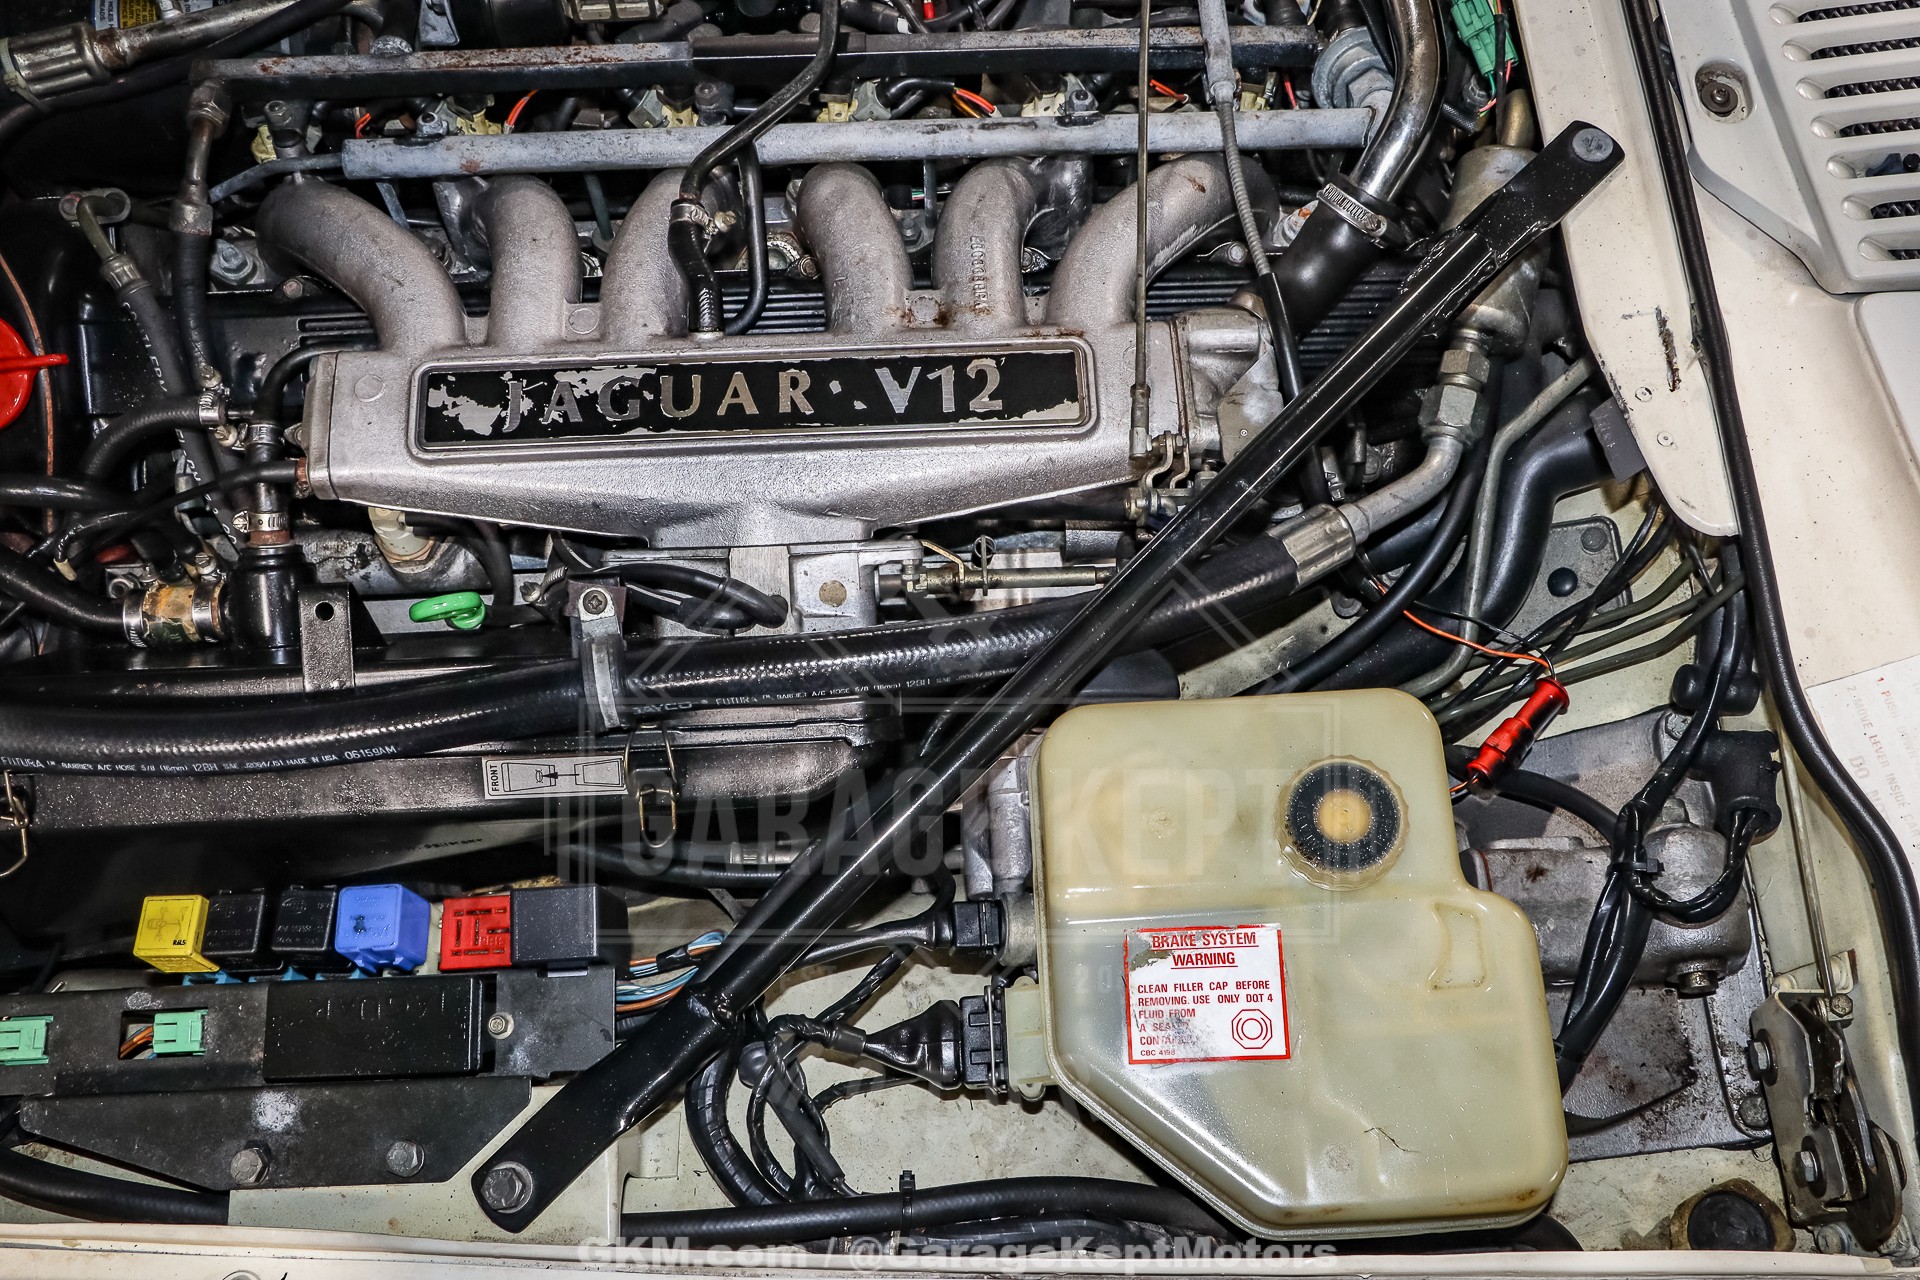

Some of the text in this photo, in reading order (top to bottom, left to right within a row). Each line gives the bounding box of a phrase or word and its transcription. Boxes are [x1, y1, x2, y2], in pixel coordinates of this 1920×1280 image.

[502, 359, 1003, 434] JAGUAR V12
[1869, 734, 1890, 769] LEVER
[97, 764, 113, 772] A/C
[287, 757, 309, 766] MADE
[321, 754, 339, 762] USA
[490, 763, 500, 792] FRONT
[1151, 931, 1257, 949] BRAKE SYSTEM
[1171, 951, 1236, 967] WARNING
[1137, 980, 1271, 994] CLEAN FILLER CAP BEFORE
[1137, 993, 1274, 1007] REMOVING. USE ONLY DOT 4
[1138, 1008, 1196, 1019] FLUID FROM
[1139, 1023, 1147, 1033] A
